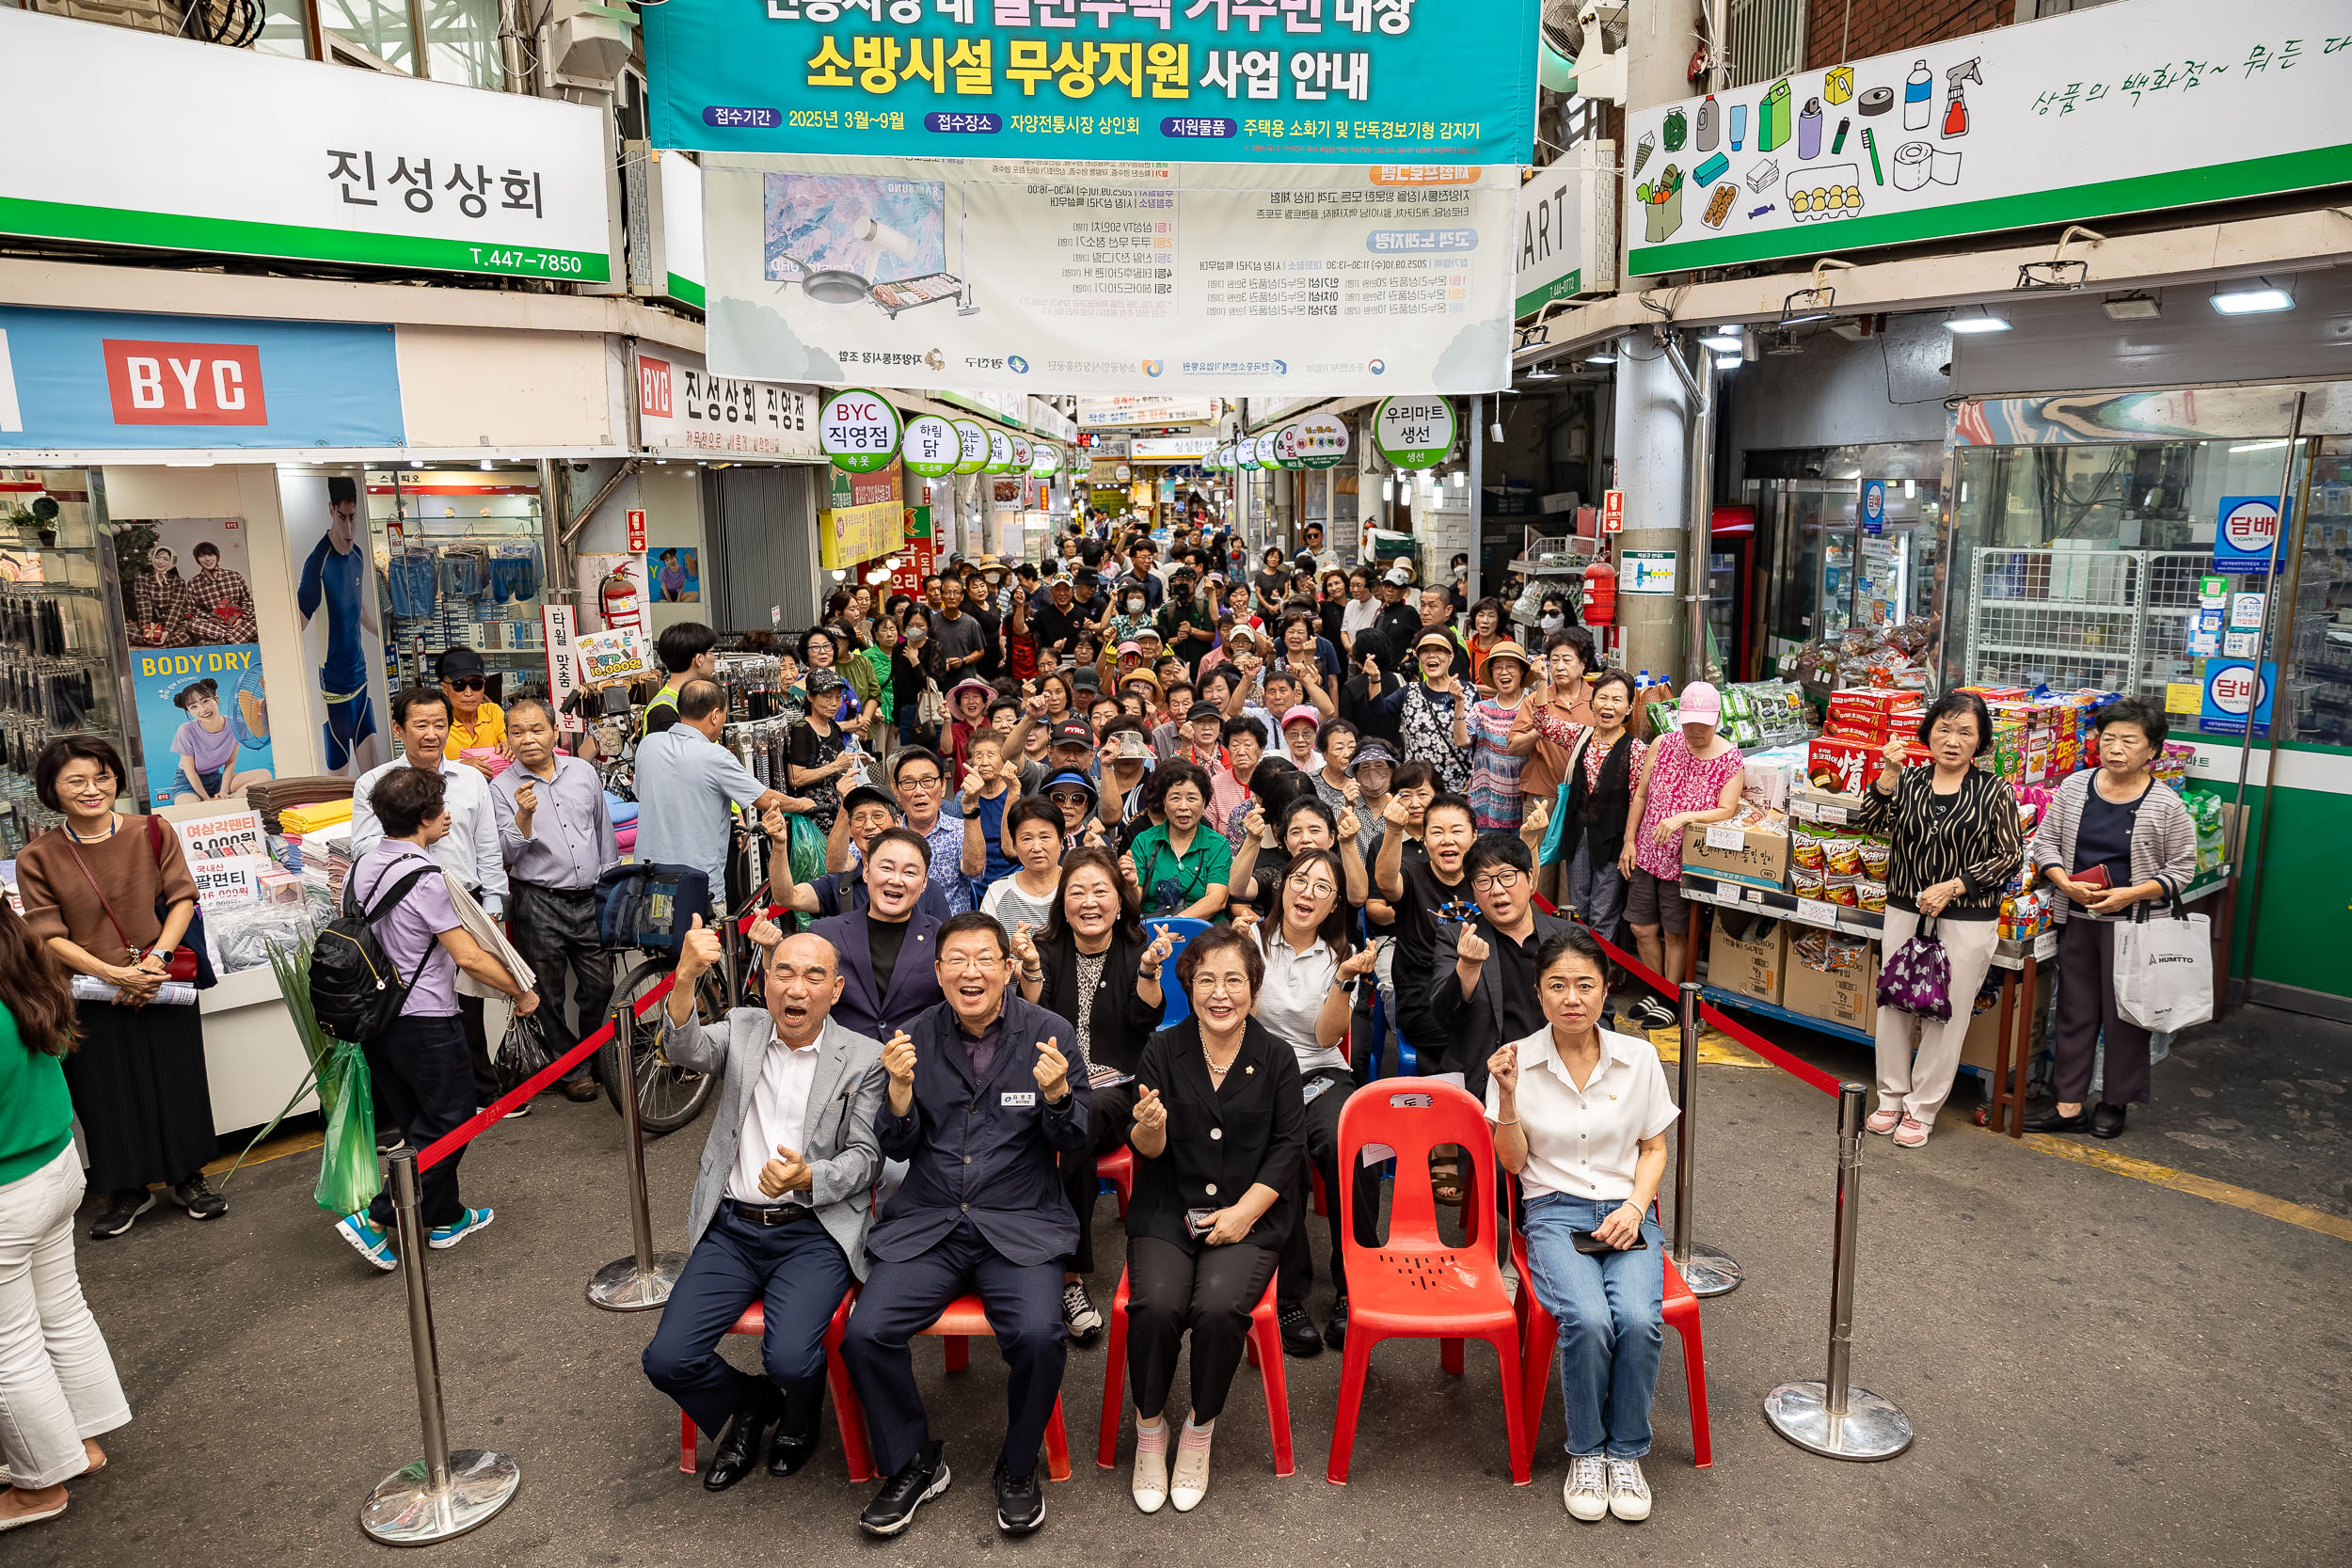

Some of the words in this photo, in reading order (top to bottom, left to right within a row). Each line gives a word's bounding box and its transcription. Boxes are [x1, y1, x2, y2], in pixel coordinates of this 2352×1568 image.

[1336, 0, 1415, 35] 대상
[806, 35, 993, 96] 소방시설
[1006, 40, 1190, 99] 무상지원
[1200, 50, 1279, 99] 사업
[1290, 51, 1369, 101] 안내
[2031, 83, 2109, 117] 상품의
[2243, 40, 2303, 79] 뭐든
[715, 107, 771, 128] 접수기간
[789, 110, 839, 129] 2025년
[844, 110, 905, 131] 3월~9월
[937, 113, 992, 133] 접수장소
[1009, 114, 1093, 134] 자양전통시장
[1097, 116, 1139, 135] 상인회
[1171, 118, 1226, 137] 지원물품
[1243, 119, 1285, 138] 주택용
[1289, 119, 1330, 139] 소화기
[1335, 120, 1348, 139] 및
[1353, 120, 1435, 141] 단독경보기형
[1439, 121, 1481, 141] 감지기
[327, 150, 544, 218] 진성상회
[1517, 184, 1566, 274] ART
[469, 248, 582, 274] T.447-7850
[127, 356, 246, 409] BYC
[643, 367, 669, 412] BYC
[685, 371, 756, 425] 진성상회
[767, 388, 804, 431] 직영점
[836, 404, 878, 421] BYC
[1385, 405, 1445, 424] 우리마트
[829, 426, 887, 448] 직영점
[920, 425, 942, 437] 하림
[1401, 426, 1430, 444] 생선
[923, 440, 939, 457] 닭
[1406, 451, 1424, 463] 생선
[2231, 517, 2276, 535] 담배
[892, 574, 918, 591] 오리
[552, 612, 566, 646] 타월
[603, 637, 632, 650] SALE
[142, 655, 203, 676] BODY
[209, 651, 252, 672] DRY
[556, 655, 571, 688] 맞춤
[591, 658, 643, 676] 10,000원
[1812, 752, 1838, 766] 초코파이
[2056, 739, 2074, 760] ZEC
[1837, 749, 1867, 797] 情
[187, 816, 256, 838] 여삼각팬티
[197, 863, 224, 872] 국내산
[196, 871, 246, 890] 팔면티
